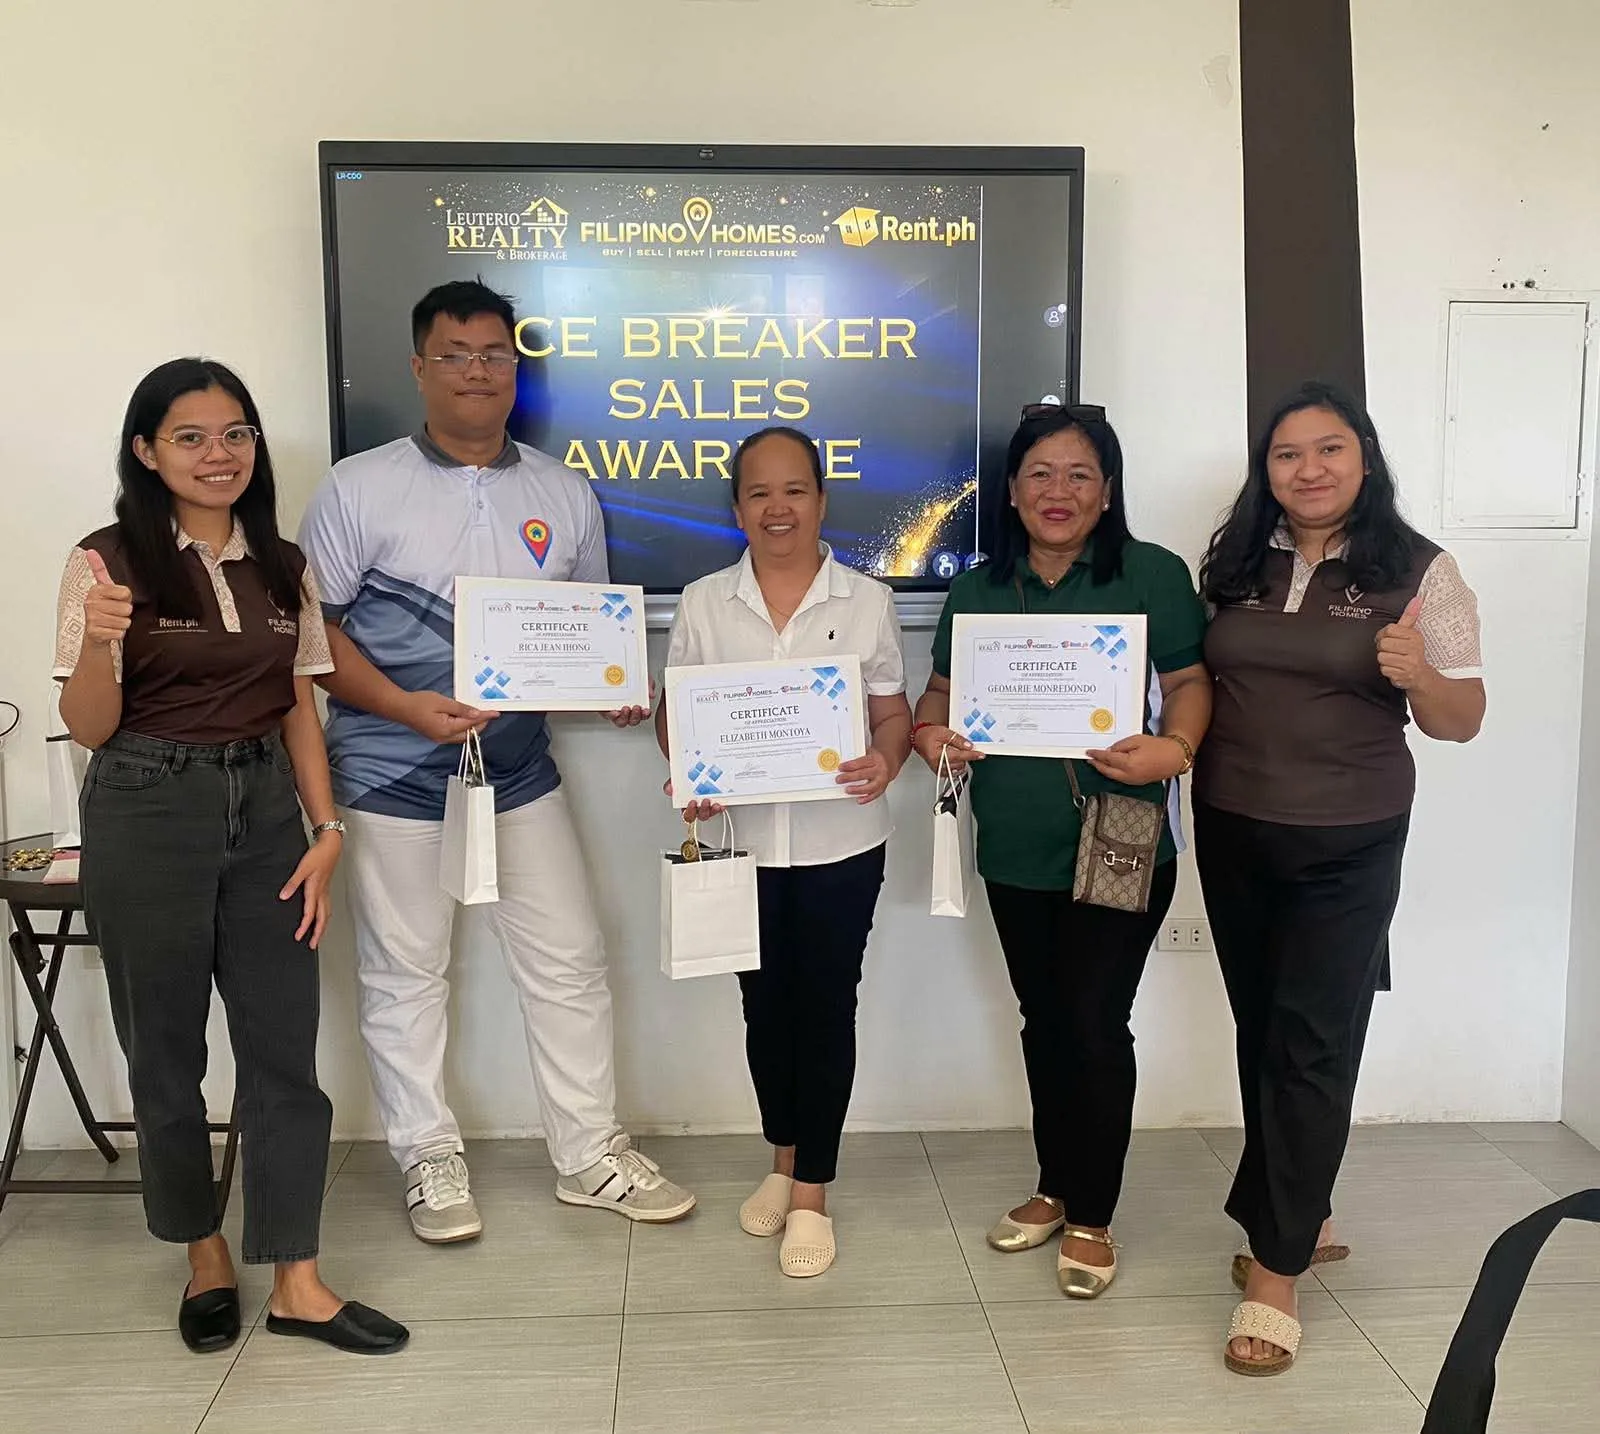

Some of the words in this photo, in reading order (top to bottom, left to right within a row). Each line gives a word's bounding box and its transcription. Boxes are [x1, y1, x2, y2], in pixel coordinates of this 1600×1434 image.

[446, 209, 520, 226] LEUTERIO
[446, 225, 568, 248] REALTY
[580, 221, 687, 243] FILIPINO
[882, 215, 976, 247] Rent.ph
[509, 249, 568, 261] BROKERAGE
[602, 248, 624, 257] BUY
[636, 249, 664, 257] SELL
[676, 249, 705, 257] RENT
[716, 249, 798, 257] FORECLOSURE
[514, 316, 598, 359] CE
[621, 316, 918, 360] BREAKER
[608, 377, 811, 421] SALES
[562, 437, 862, 480] AWARE
[521, 622, 589, 631] CERTIFICATE
[519, 643, 539, 652] RICA
[540, 643, 561, 652] JEAN
[1008, 661, 1078, 671] CERTIFICATE
[987, 684, 1032, 693] GEOMARIE
[1033, 684, 1097, 693] MONREDONDO
[730, 705, 800, 720] CERTIFICATE
[720, 730, 767, 743] ELIZABETH
[769, 727, 811, 740] MONTOYA
